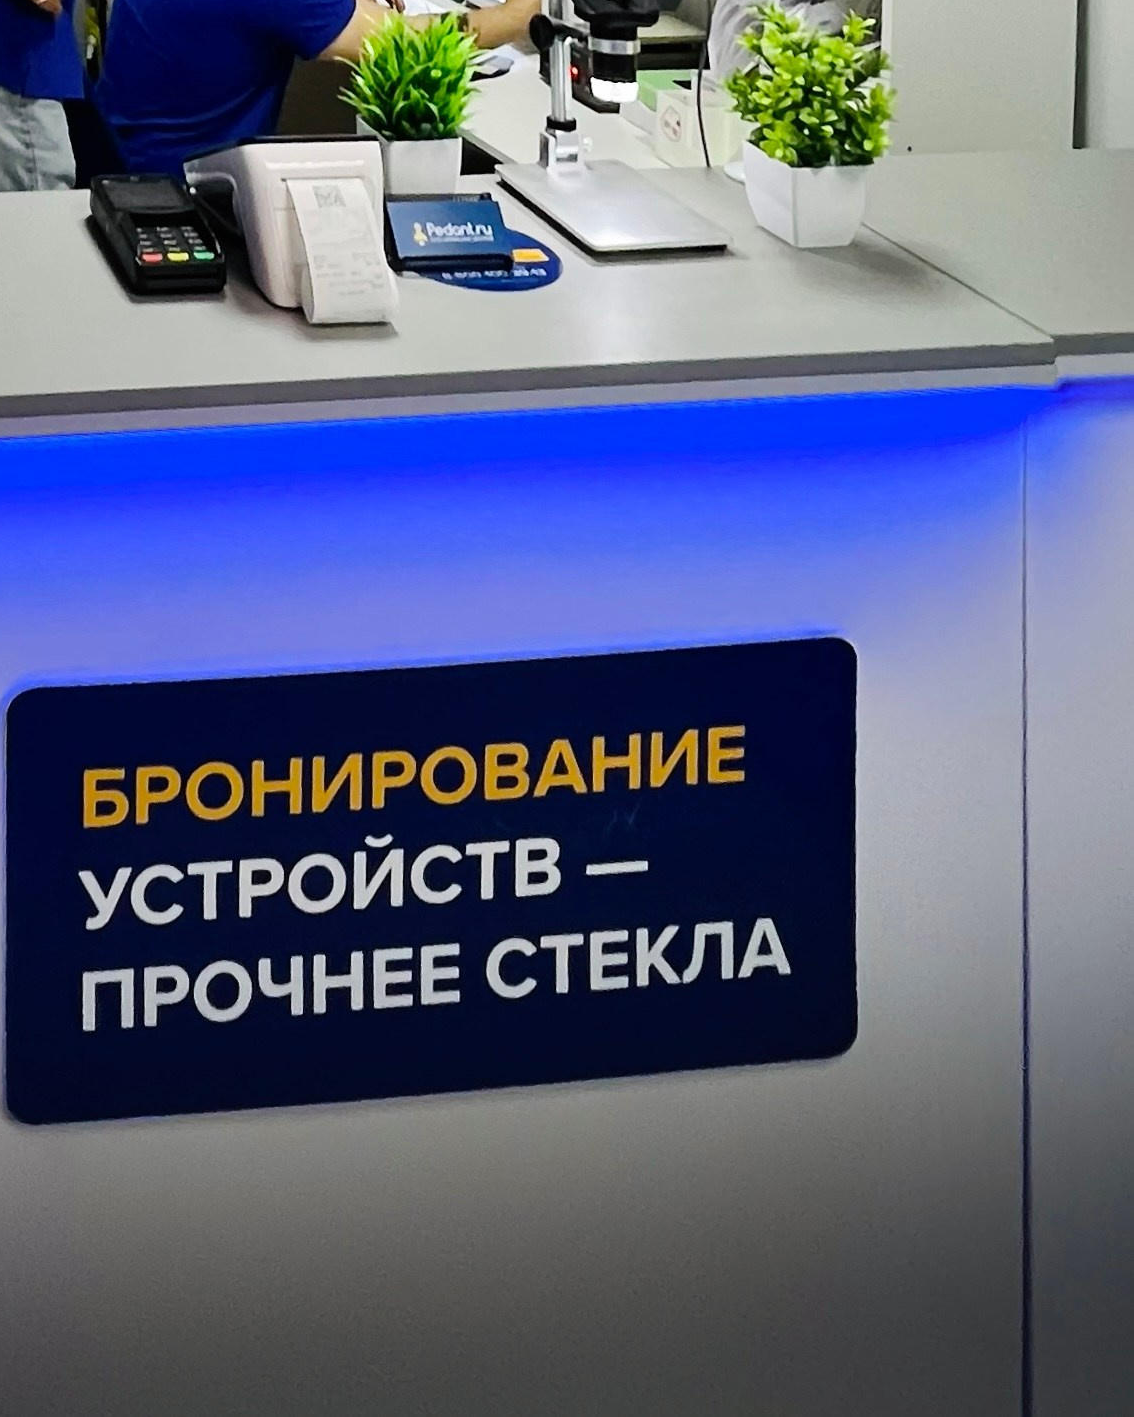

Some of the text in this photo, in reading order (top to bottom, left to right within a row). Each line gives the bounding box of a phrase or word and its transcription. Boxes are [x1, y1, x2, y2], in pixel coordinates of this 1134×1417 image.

[81, 724, 748, 830] БРОНИРОВАНИЕ
[78, 834, 563, 932] УСТРОЙСТВ
[79, 915, 792, 1033] ПРОЧНЕЕ СТЕКЛА
